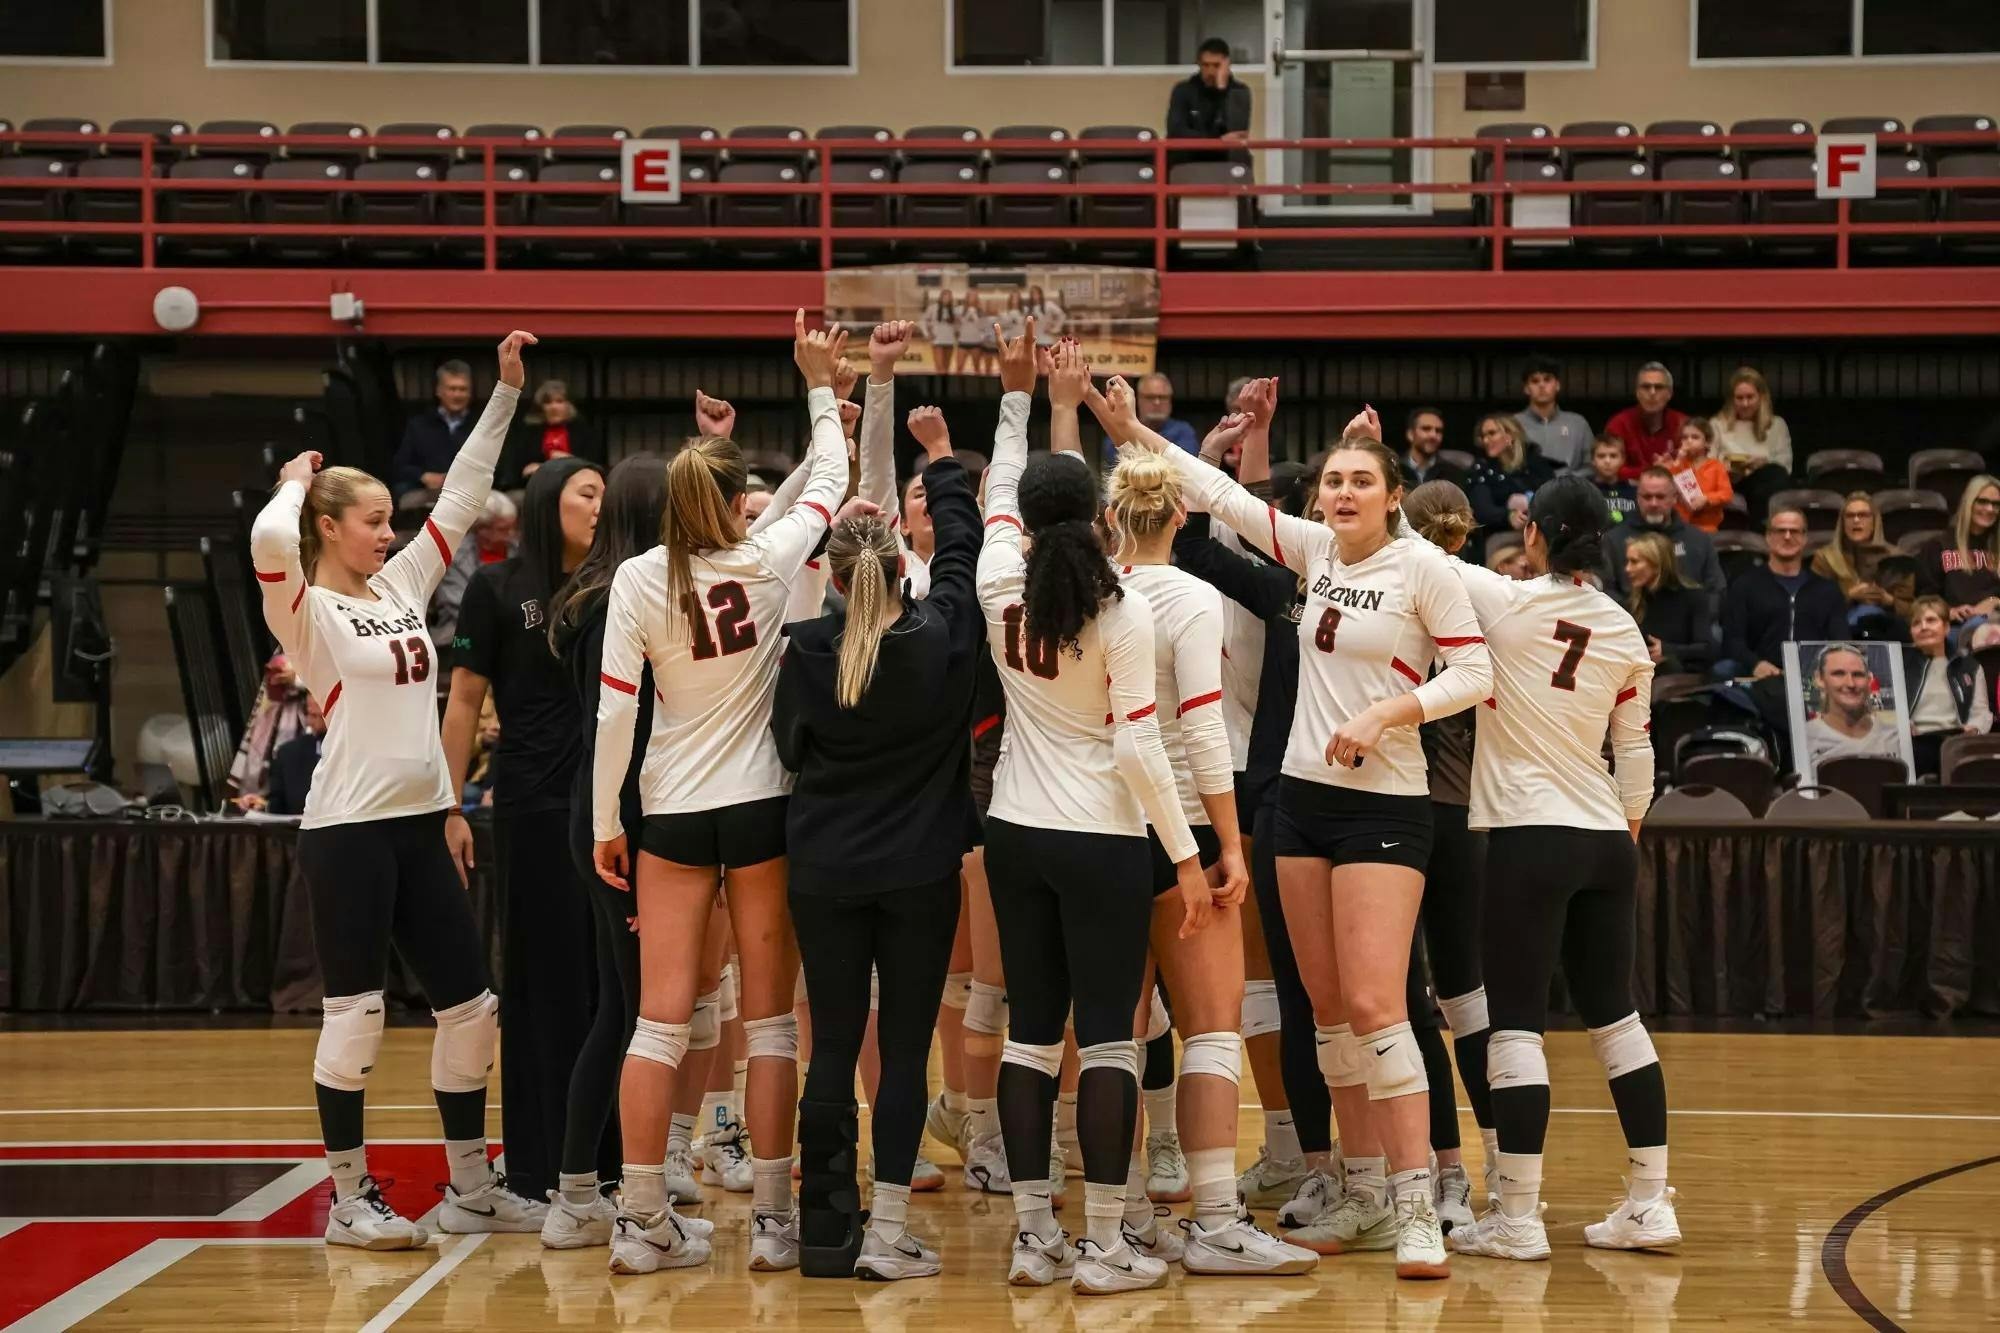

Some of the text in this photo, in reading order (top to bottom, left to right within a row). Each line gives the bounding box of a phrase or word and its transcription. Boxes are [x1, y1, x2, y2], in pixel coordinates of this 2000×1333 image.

[633, 150, 669, 191] E
[1828, 145, 1866, 188] F
[521, 599, 543, 629] B
[1312, 574, 1384, 611] BROWN
[679, 580, 758, 661] 12
[1003, 603, 1060, 680] 10
[1314, 607, 1342, 654] 8
[389, 636, 430, 685] 13
[1551, 619, 1592, 691] 7
